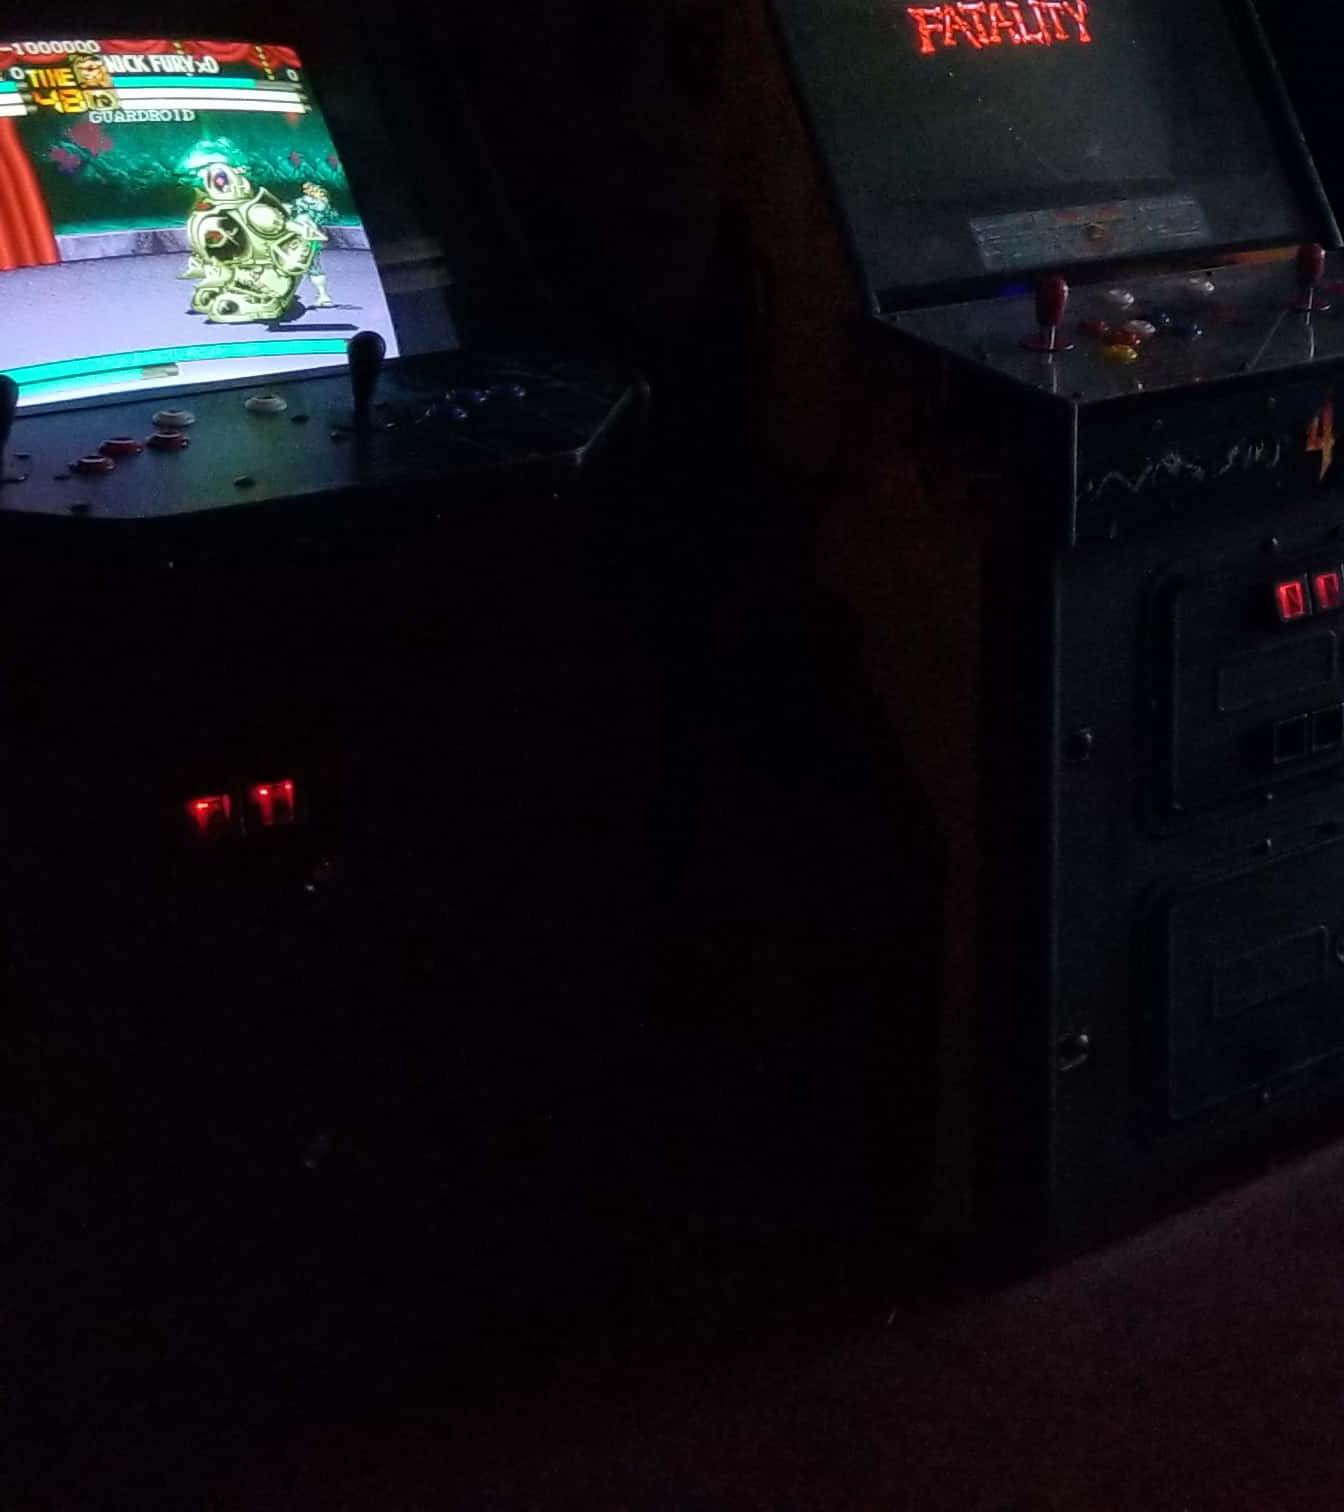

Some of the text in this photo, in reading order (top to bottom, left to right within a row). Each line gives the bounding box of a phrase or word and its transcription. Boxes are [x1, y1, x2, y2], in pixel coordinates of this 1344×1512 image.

[103, 54, 152, 73] NICK
[151, 54, 194, 75] FURY
[25, 68, 77, 89] TIME
[89, 109, 195, 124] GUARDROID
